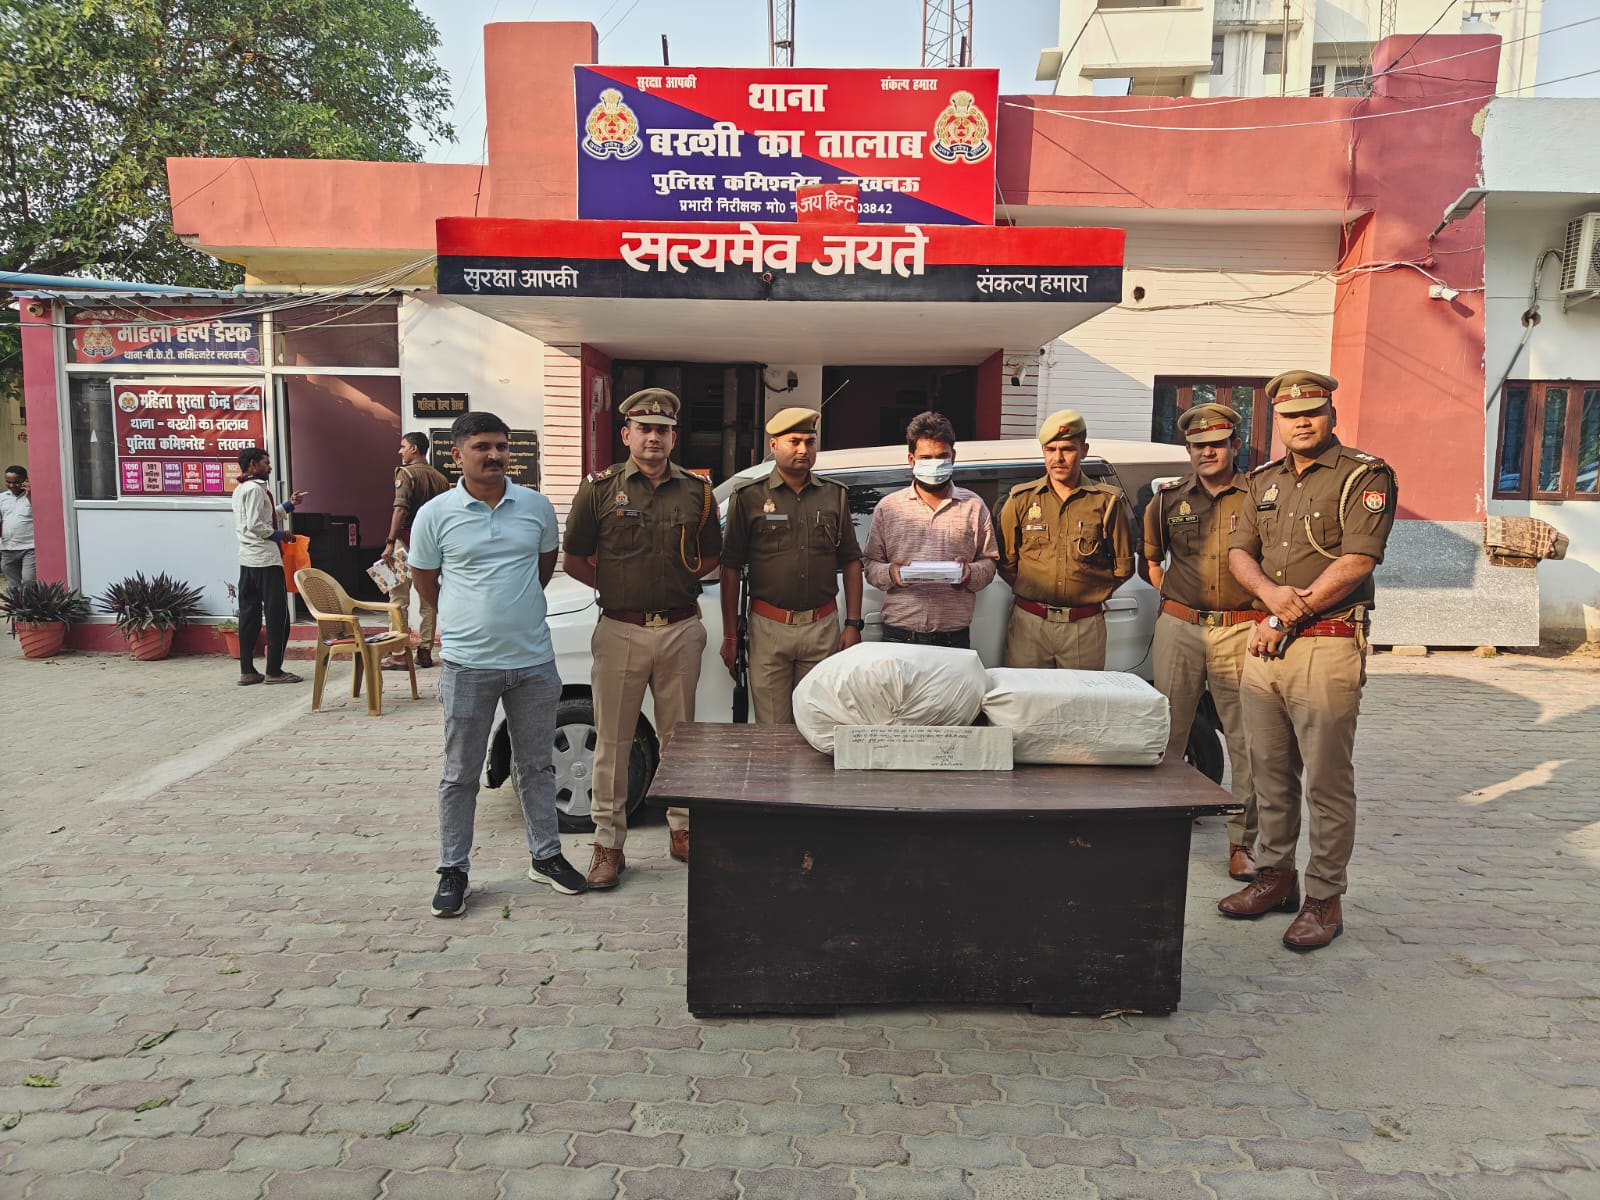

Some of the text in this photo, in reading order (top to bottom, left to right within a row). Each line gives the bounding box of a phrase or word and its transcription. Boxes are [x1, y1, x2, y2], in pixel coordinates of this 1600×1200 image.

[636, 75, 697, 93] सुरक्षा आपकी
[880, 75, 938, 91] संकल्प हमारा
[748, 83, 828, 113] थाना
[646, 121, 745, 158] बख्शी
[754, 129, 805, 159] का
[814, 130, 927, 159] तालाब
[652, 169, 716, 195] पुलिस
[679, 197, 712, 214] प्रभारी
[717, 197, 761, 214] निरीक्षक
[798, 190, 858, 213] जय हिन्द
[620, 222, 930, 278] सत्यमेव जयते
[463, 266, 579, 291] सुरक्षा आपकी
[976, 271, 1088, 296] संकल्प हमारा
[212, 320, 253, 343] डेस्क
[139, 390, 173, 410] महिला
[176, 393, 206, 414] सुरक्षा
[131, 418, 155, 430] थाना
[198, 419, 214, 431] का
[216, 419, 249, 431] तालाब
[126, 435, 156, 455] पुलिस
[159, 435, 206, 451] कमिश्नरेट
